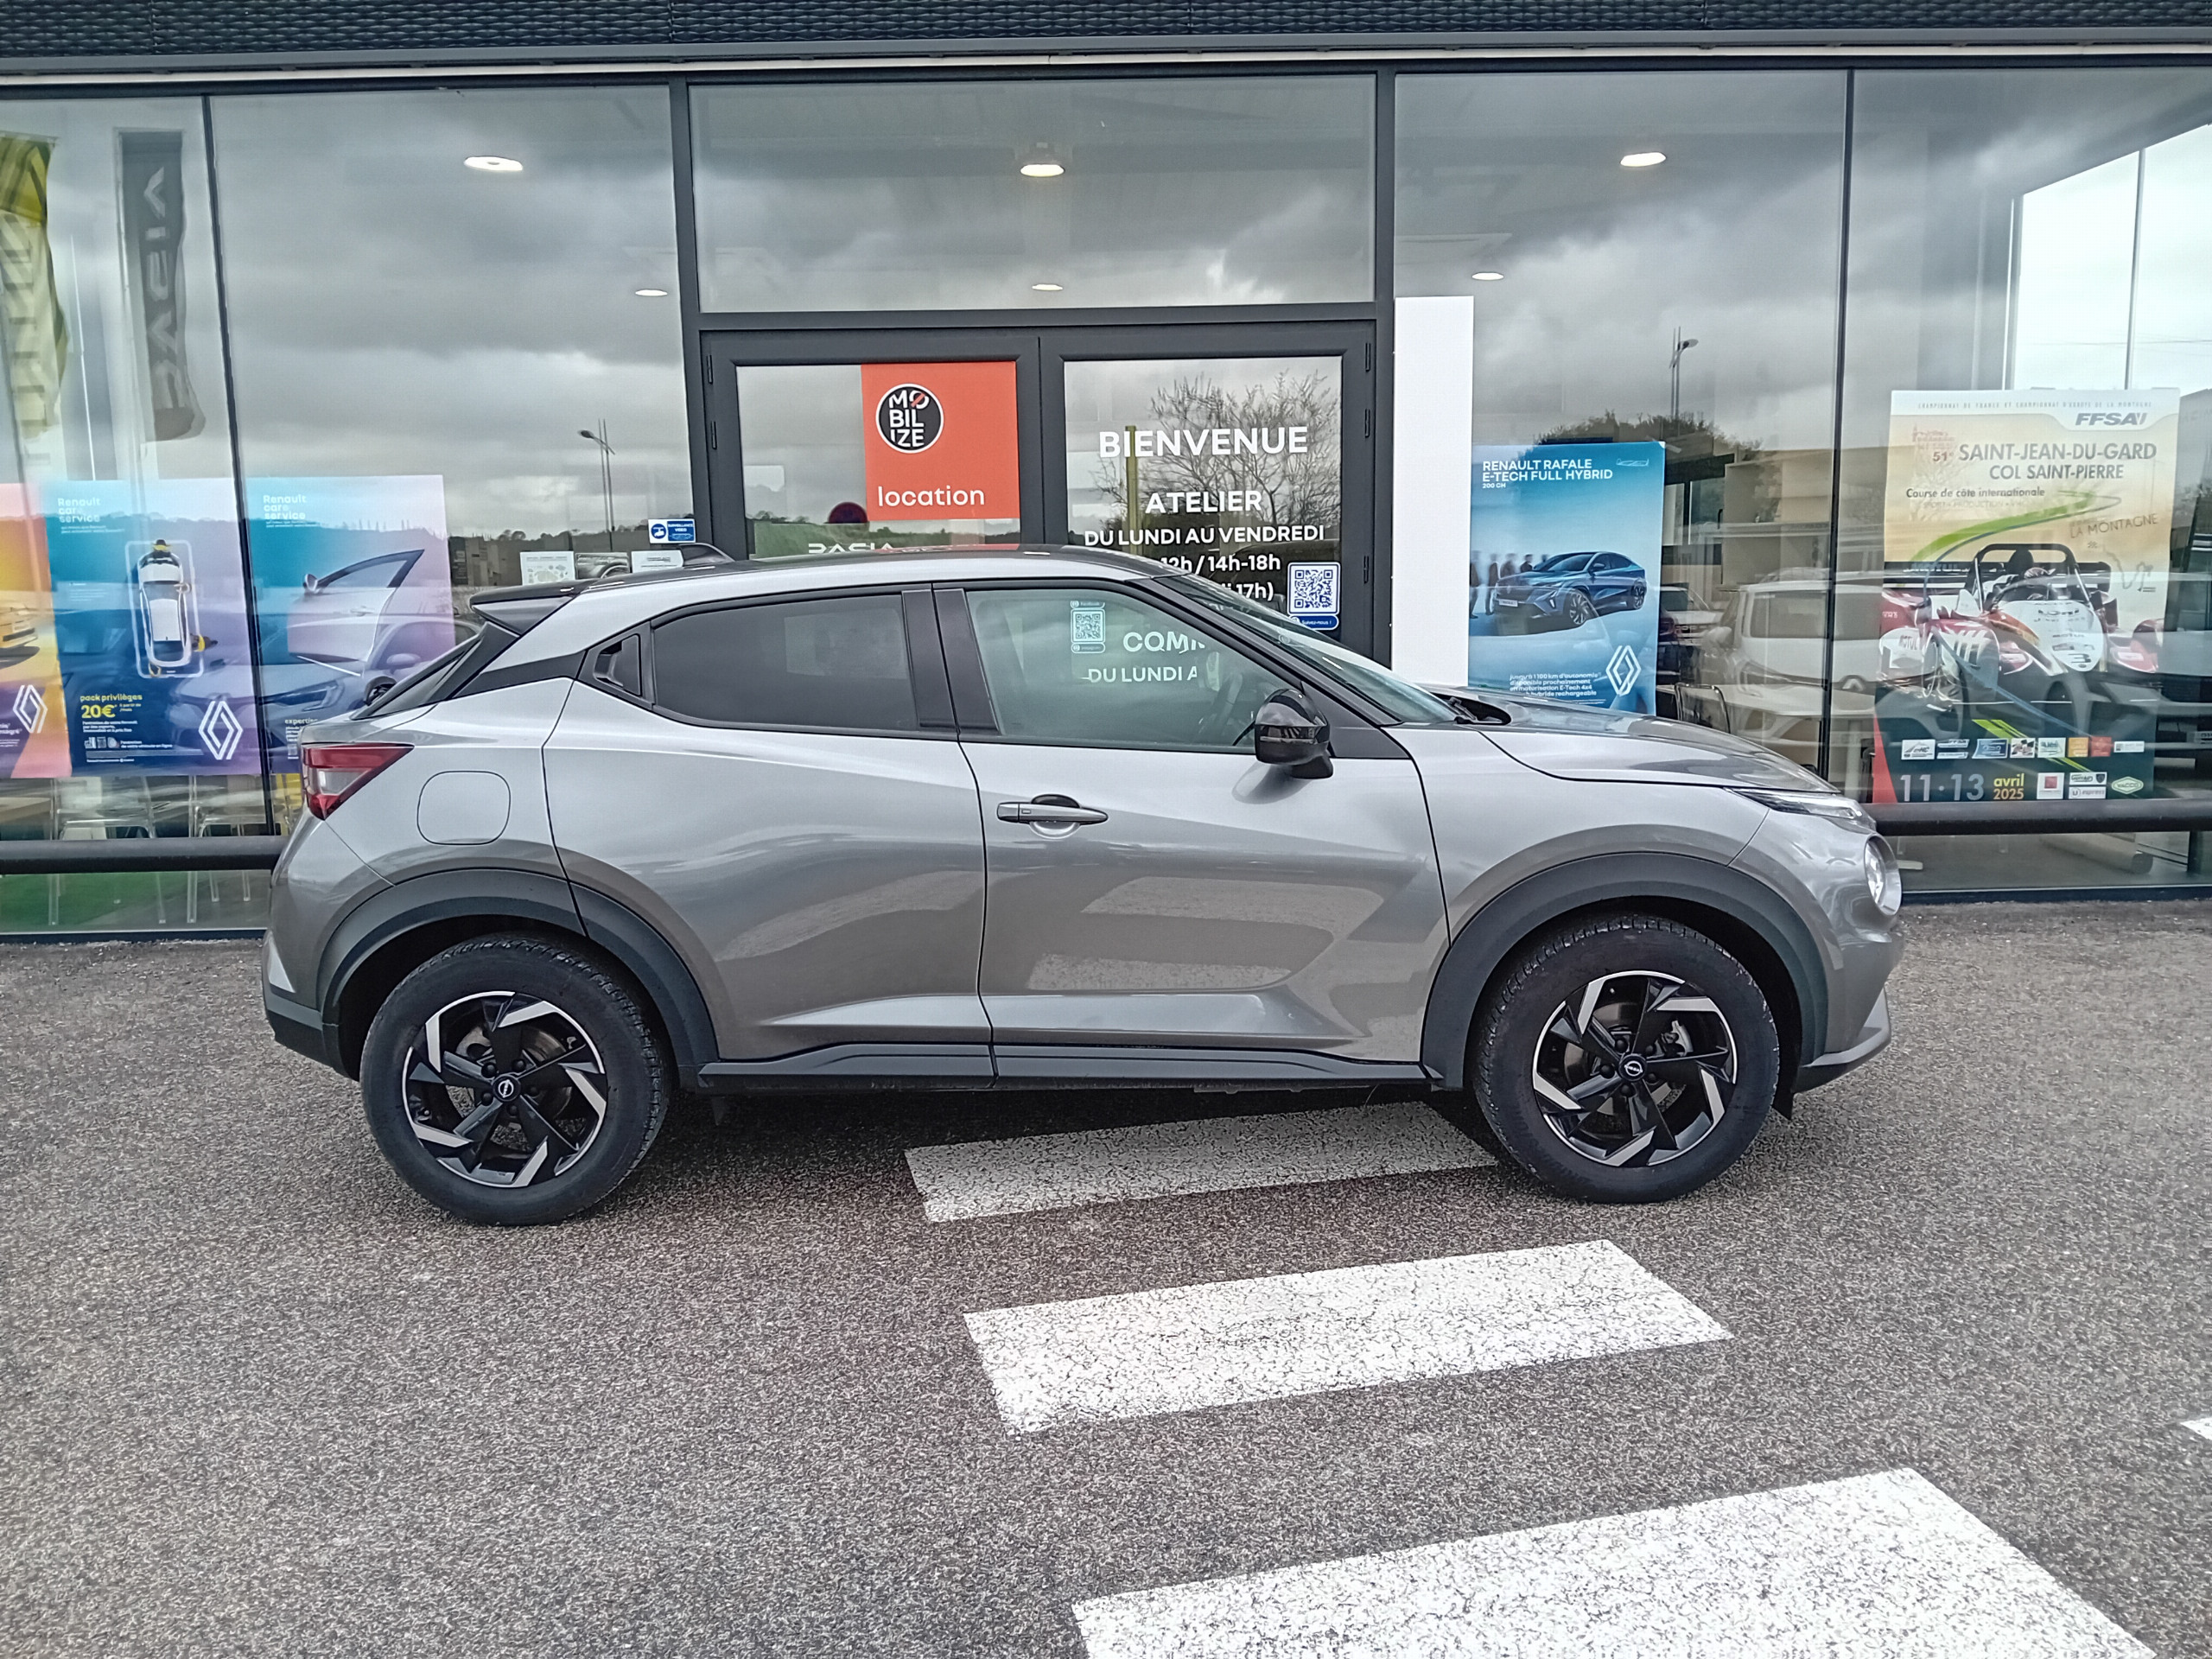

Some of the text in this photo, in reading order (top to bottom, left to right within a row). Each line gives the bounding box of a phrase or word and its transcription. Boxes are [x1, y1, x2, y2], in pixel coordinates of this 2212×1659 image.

[2075, 412, 2139, 426] FFSA
[1099, 426, 1308, 458] BIENVENUE
[1958, 442, 2157, 461] SAINT-JEAN-DU-GARD
[1483, 459, 1592, 472] RENAULT RAFALE
[1989, 464, 2125, 480] COL SAINT-PIERRE
[1482, 469, 1613, 482] E-TECH FULL HYBRID
[263, 493, 307, 504] Renault
[878, 486, 985, 507] location
[1905, 486, 2045, 498] Course de côte internationale
[57, 497, 101, 507] Renault
[1145, 490, 1262, 514] ATELIER
[59, 514, 101, 524] service
[264, 512, 306, 520] service
[2088, 513, 2158, 534] MONTAGNE
[1084, 524, 1325, 546] DU LUNDI AU VENDREDI
[1208, 554, 1281, 571] 14h-18h
[1088, 668, 1116, 683] DU
[1122, 666, 1182, 683] LUNDI
[79, 694, 100, 703] pack
[1993, 772, 2024, 787] avril
[1993, 788, 2024, 800] 2025
